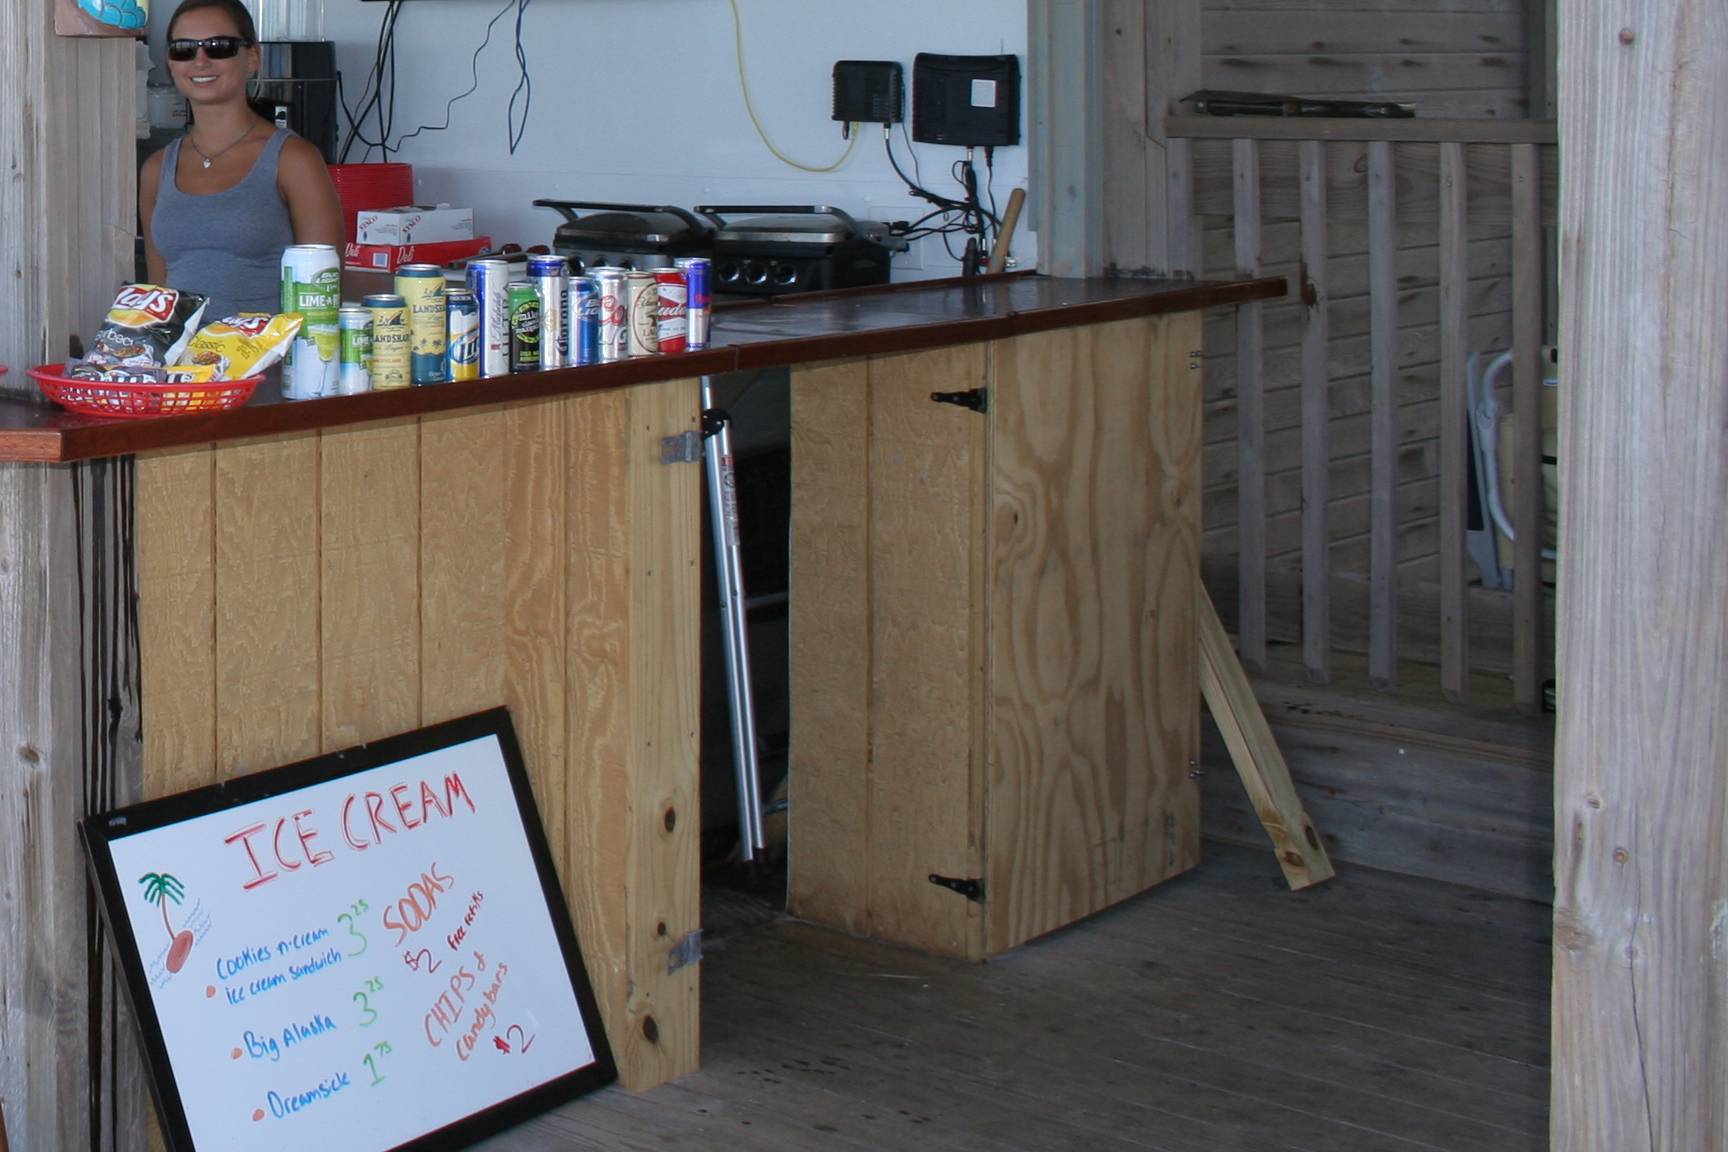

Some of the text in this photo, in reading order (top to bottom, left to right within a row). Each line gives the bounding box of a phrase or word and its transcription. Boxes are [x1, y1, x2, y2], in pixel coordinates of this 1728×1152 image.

[224, 771, 476, 891] ICE CREAM
[383, 861, 454, 948] SODAS
[249, 974, 287, 996] cream
[288, 947, 343, 981] sandwich
[403, 948, 442, 974] $2
[482, 962, 508, 1005] bars
[425, 966, 476, 1047] CHIPS
[243, 1030, 281, 1062] Big
[282, 1014, 337, 1047] Alaska
